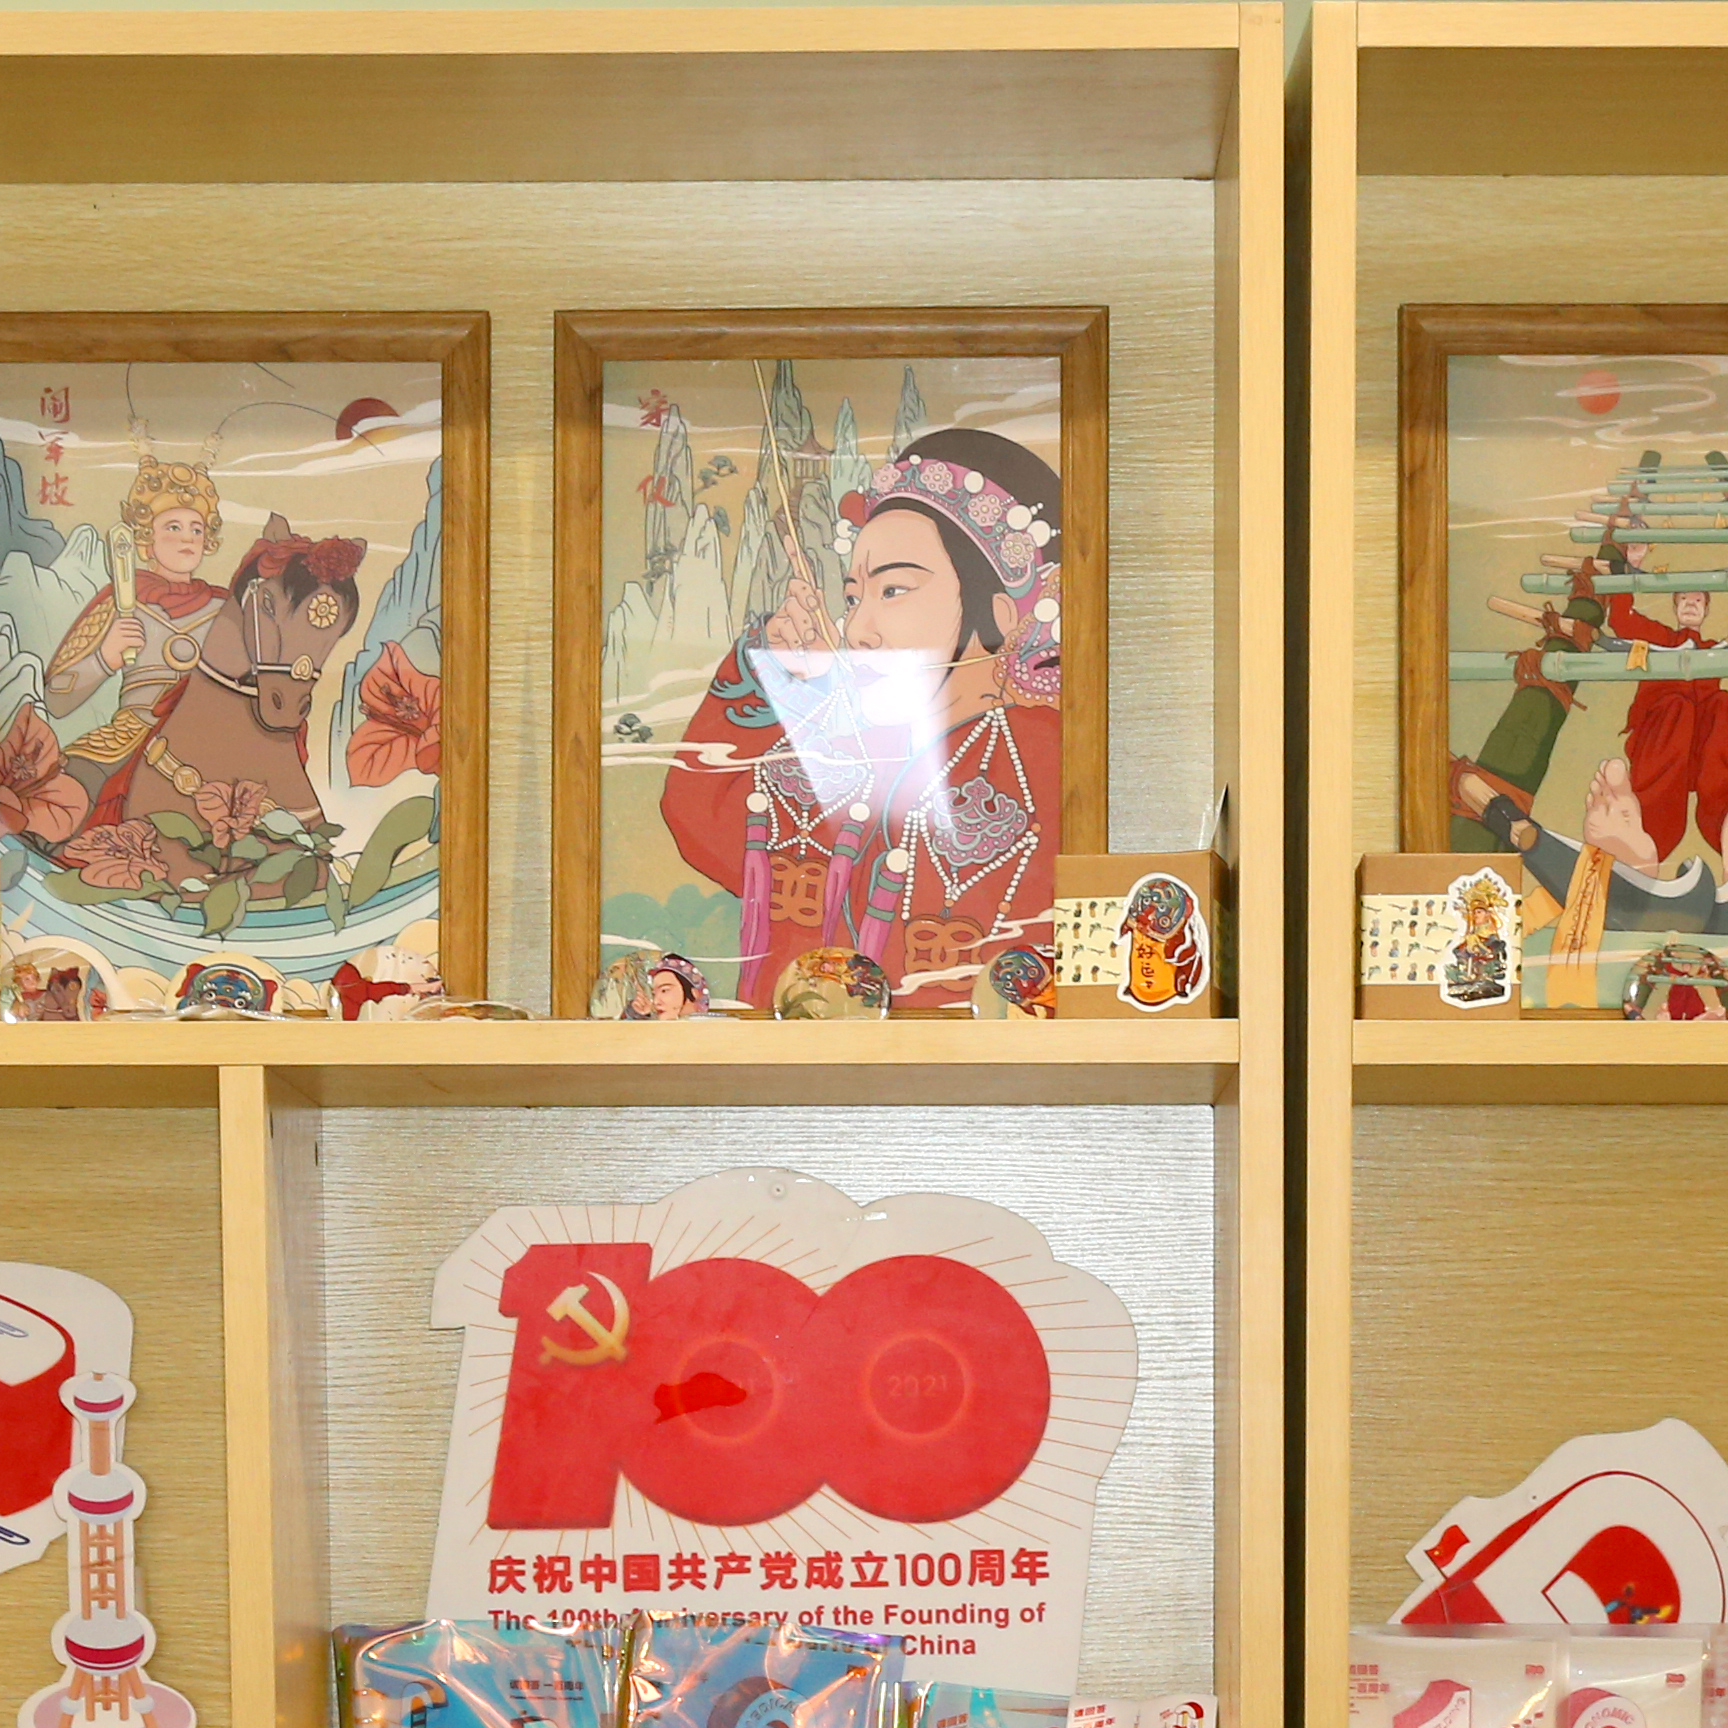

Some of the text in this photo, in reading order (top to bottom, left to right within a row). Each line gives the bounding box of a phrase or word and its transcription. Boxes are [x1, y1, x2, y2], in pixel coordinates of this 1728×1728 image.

[487, 1242, 1050, 1529] 100
[888, 1374, 948, 1398] 2021
[488, 1547, 1050, 1595] 庆祝中国共产党成立100周年
[798, 1606, 825, 1626] of
[833, 1605, 874, 1626] the
[883, 1602, 1010, 1628] Founding
[1019, 1602, 1046, 1623] of
[902, 1634, 976, 1656] China
